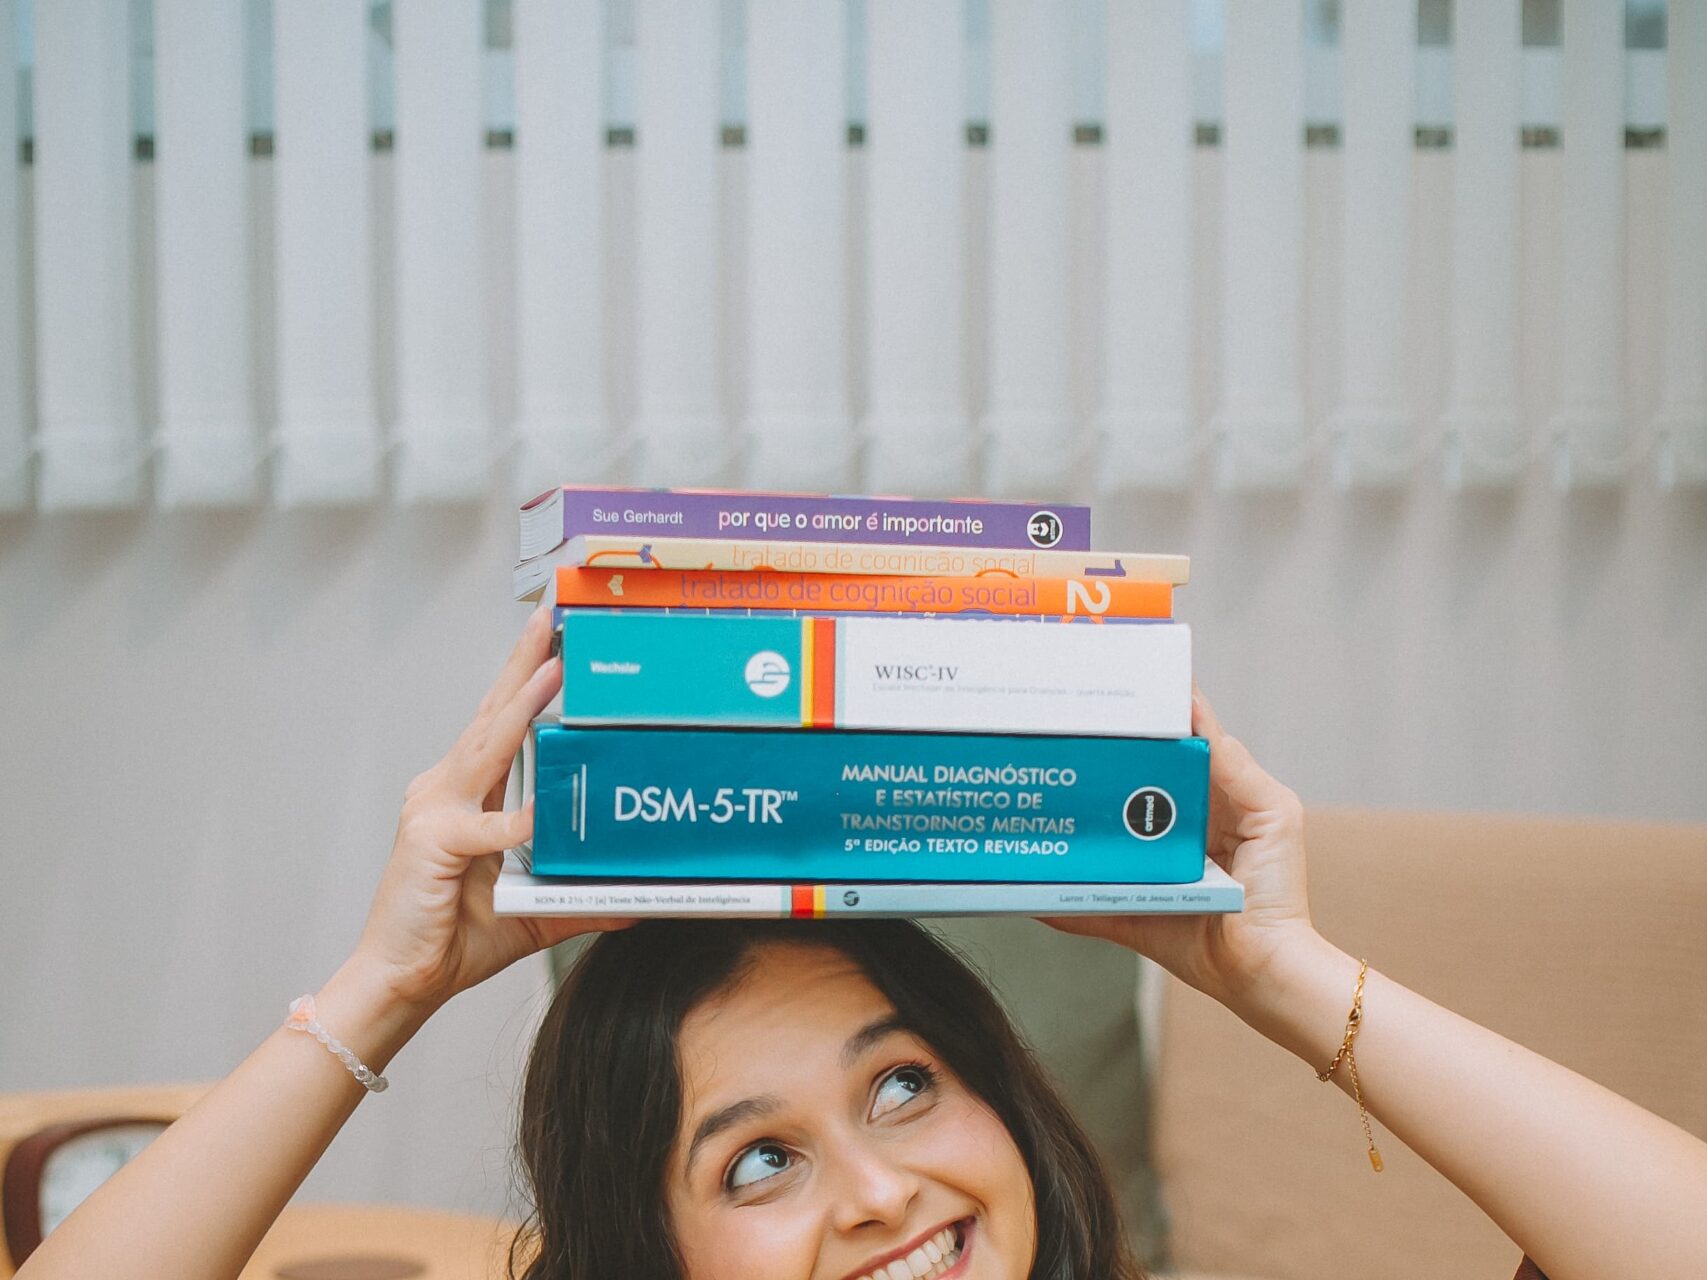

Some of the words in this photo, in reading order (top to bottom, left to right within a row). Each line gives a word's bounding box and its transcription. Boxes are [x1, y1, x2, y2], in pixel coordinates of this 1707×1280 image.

[592, 508, 620, 523] Sue
[623, 509, 683, 525] Gerhardt
[718, 511, 750, 530] por
[755, 512, 791, 532] que
[795, 513, 808, 529] o
[812, 513, 862, 530] amor
[866, 512, 879, 531] é
[882, 512, 984, 536] importante
[732, 544, 817, 569] tratado
[824, 546, 853, 570] de
[680, 573, 780, 600] tratado
[787, 578, 822, 601] de
[829, 580, 954, 610] cognição
[961, 581, 1037, 608] social
[1066, 579, 1111, 614] 2
[841, 764, 928, 782] MANUAL
[934, 763, 1077, 787] DIAGNÓSTICO
[875, 789, 886, 806] E
[892, 787, 1011, 809] ESTATÍSTICO
[1017, 792, 1043, 809] DE
[840, 813, 985, 833] TRANSTORNOS
[992, 817, 1075, 834] MENTAIS
[865, 838, 921, 854] EDIÇÃO
[927, 838, 978, 854] TEXTO
[984, 840, 1069, 856] REVISADO
